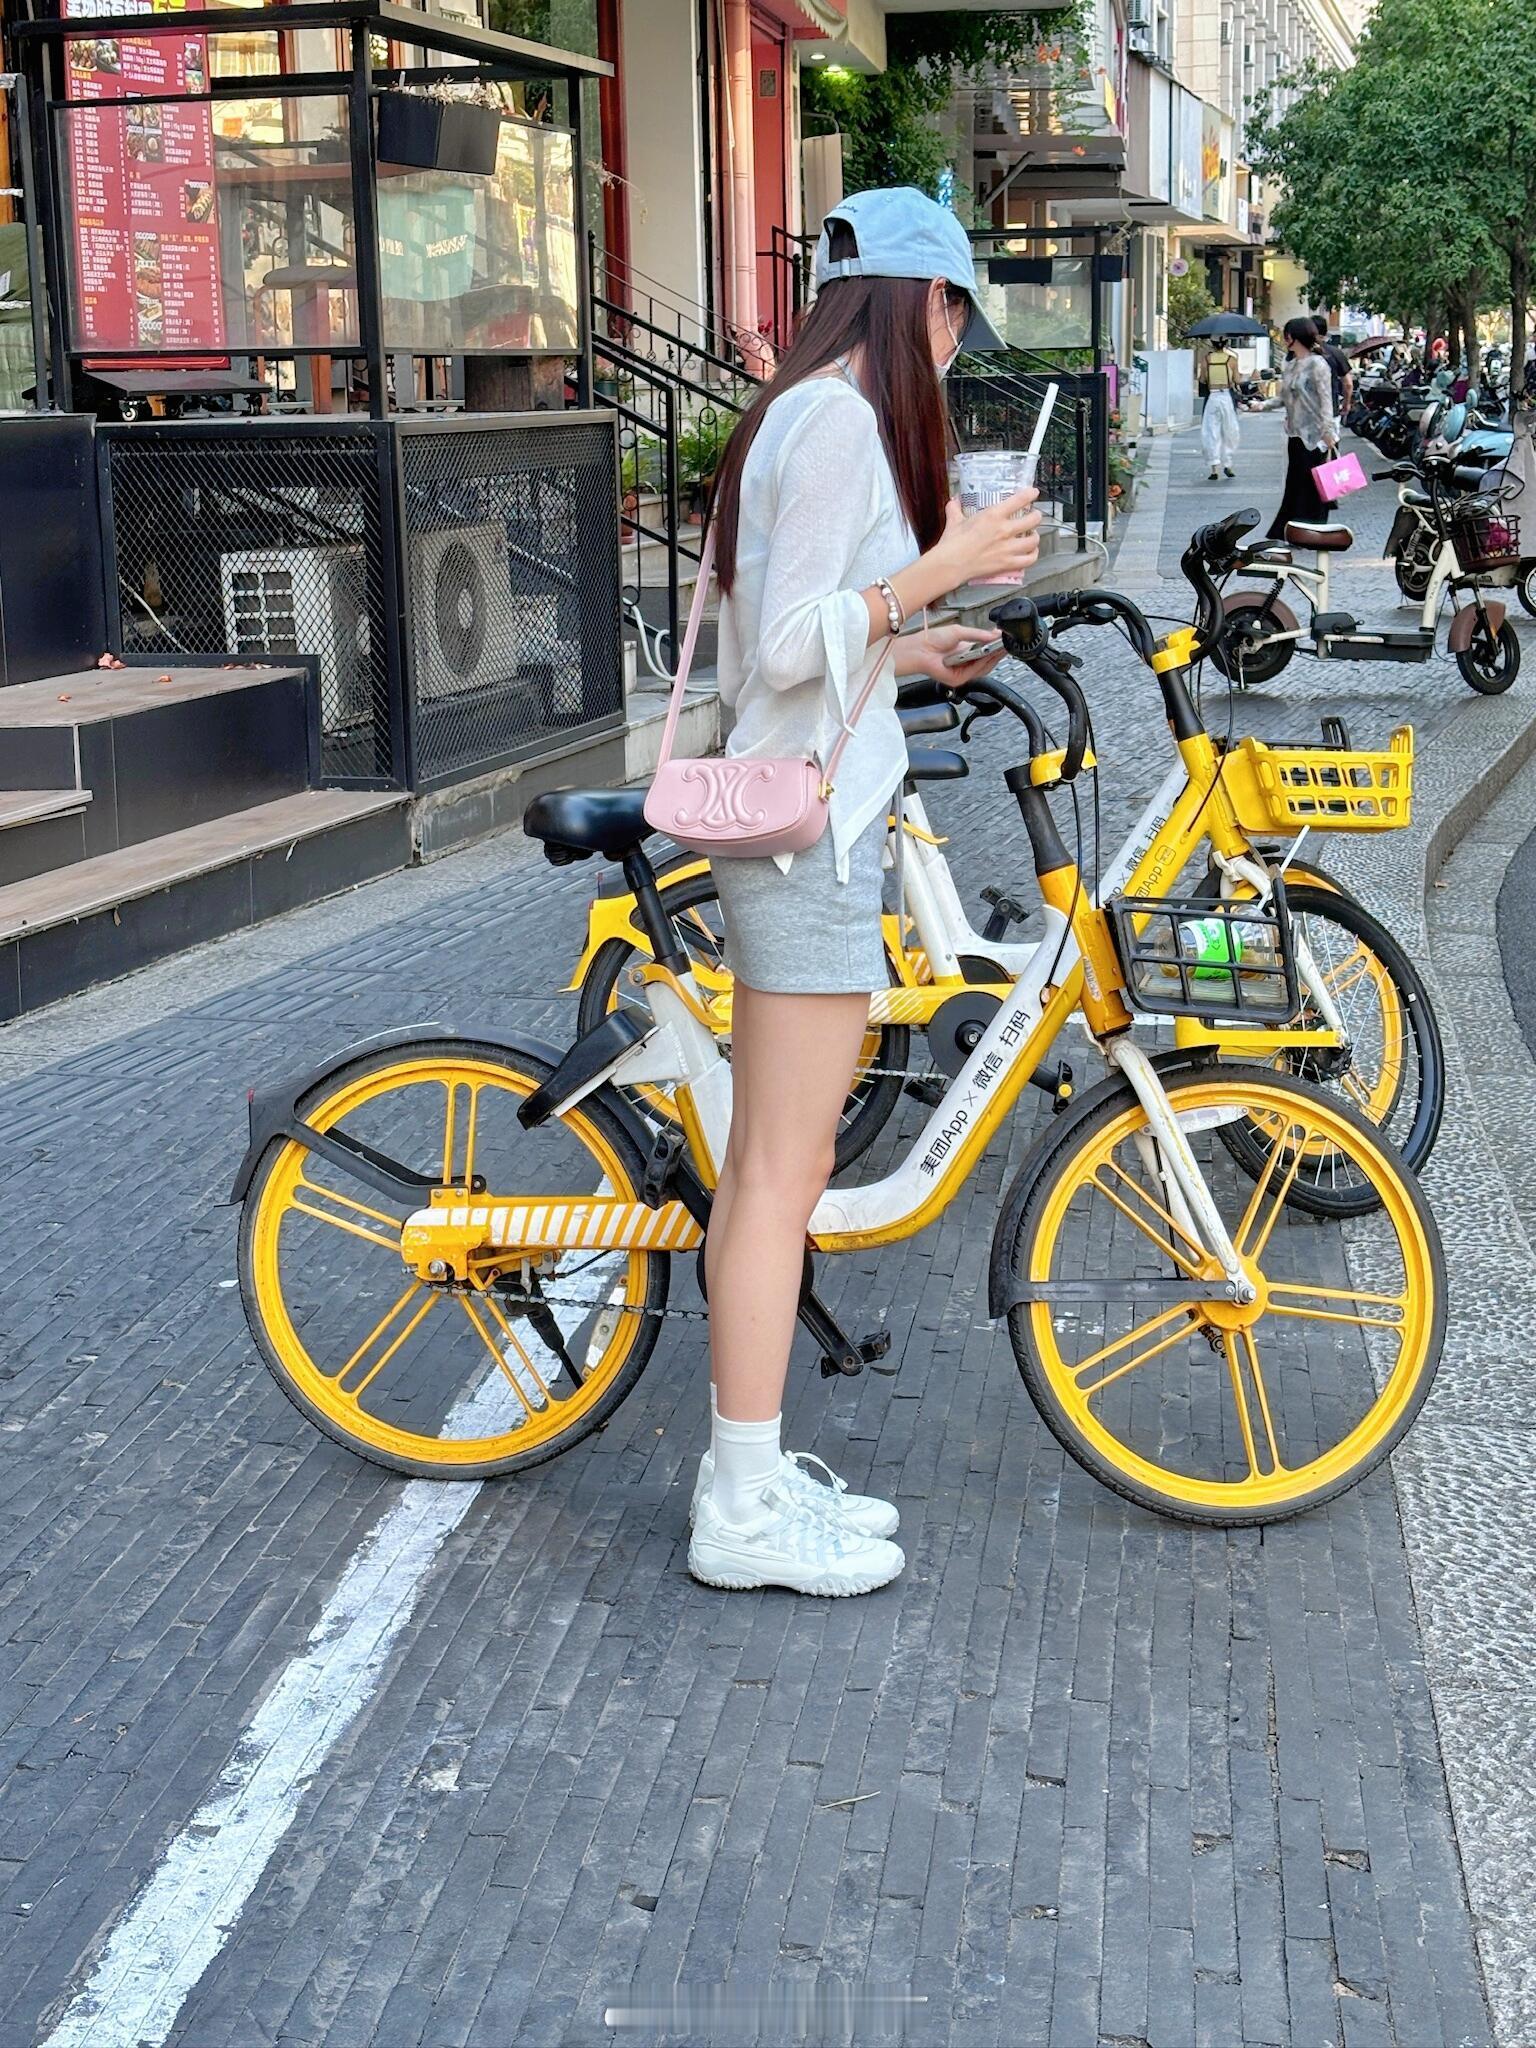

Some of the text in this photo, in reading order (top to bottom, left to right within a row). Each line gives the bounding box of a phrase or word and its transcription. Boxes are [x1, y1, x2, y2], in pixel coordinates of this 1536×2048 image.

[1145, 815, 1166, 841] 扫码
[1135, 865, 1162, 897] 团App
[919, 1109, 969, 1177] 美团App
[971, 1051, 1004, 1091] 微信
[999, 1009, 1031, 1047] 扫码
